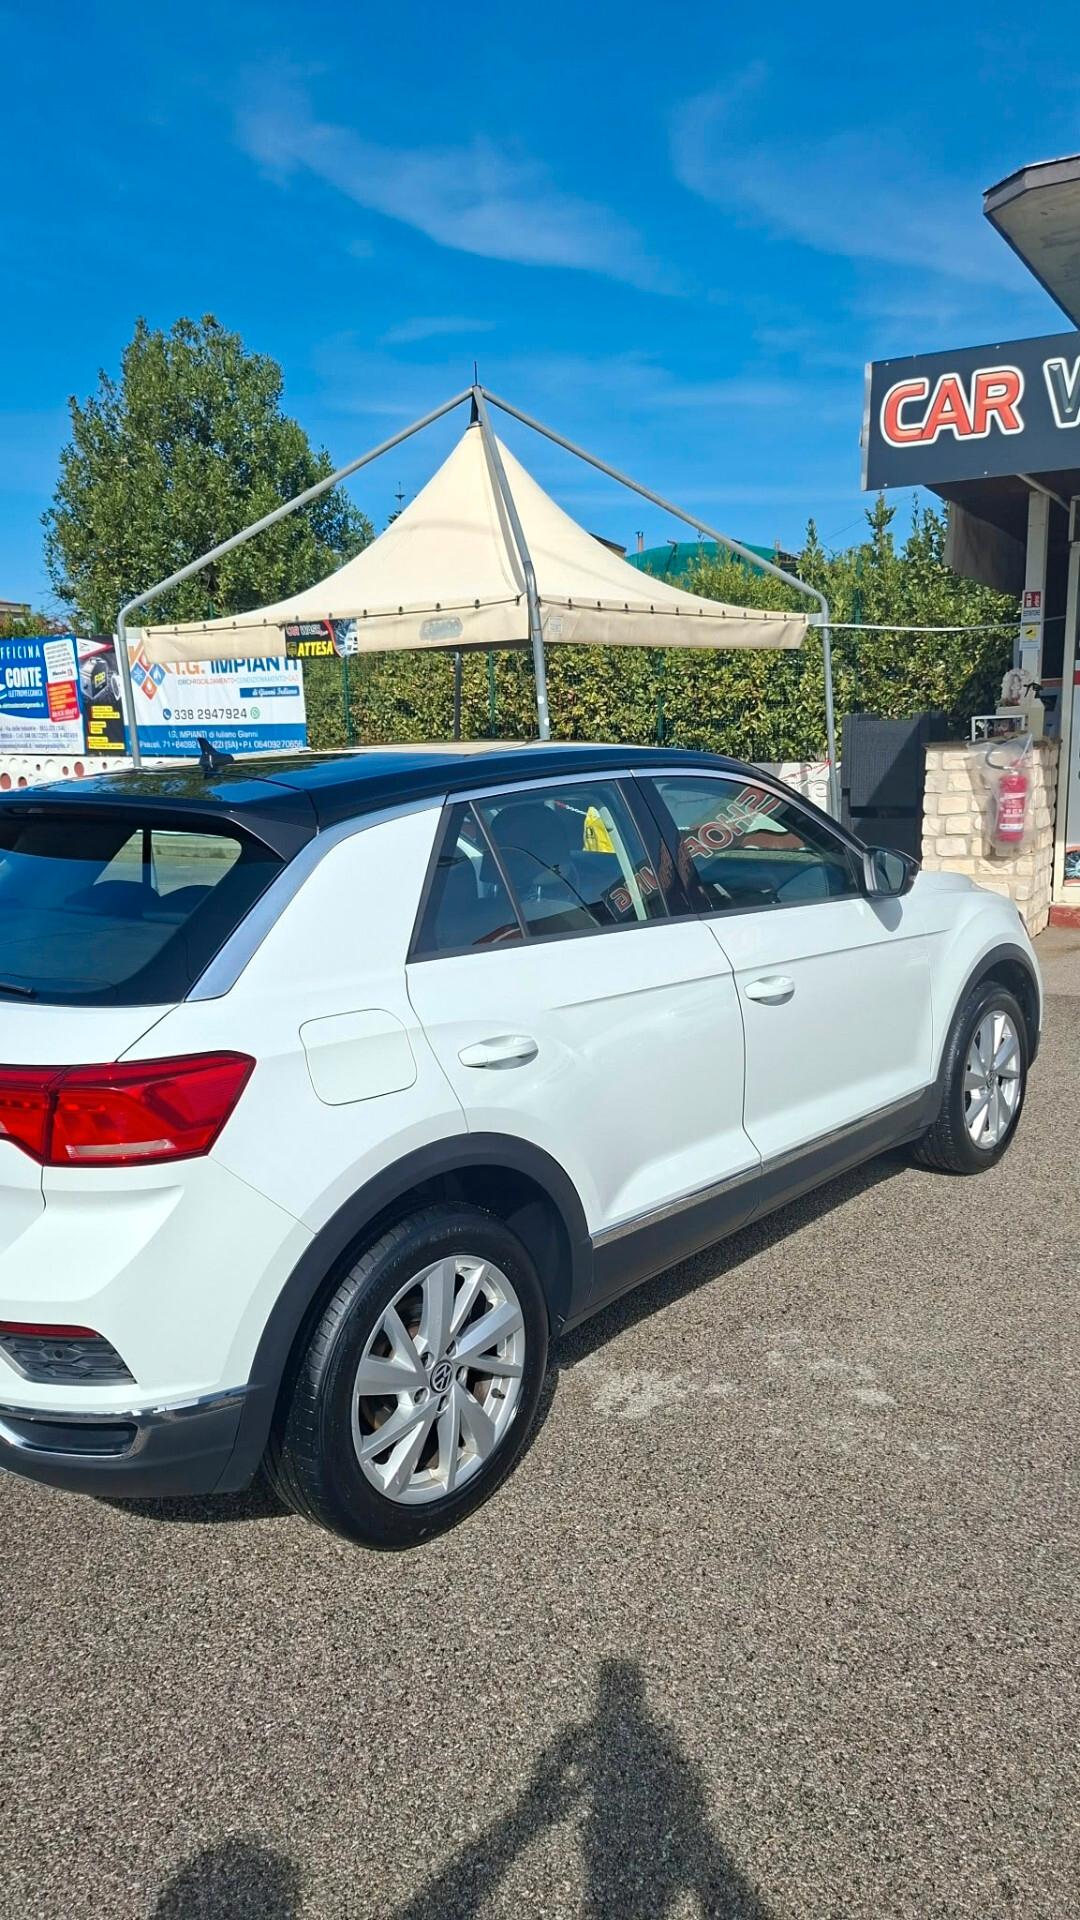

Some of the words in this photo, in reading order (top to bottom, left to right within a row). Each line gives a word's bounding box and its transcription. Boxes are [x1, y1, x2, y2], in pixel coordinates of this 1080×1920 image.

[880, 365, 1025, 448] CAR
[298, 641, 334, 656] ATTESA
[5, 666, 43, 688] CONTE
[174, 709, 194, 720] 338
[197, 708, 248, 720] 2947924
[237, 729, 259, 737] Gianni
